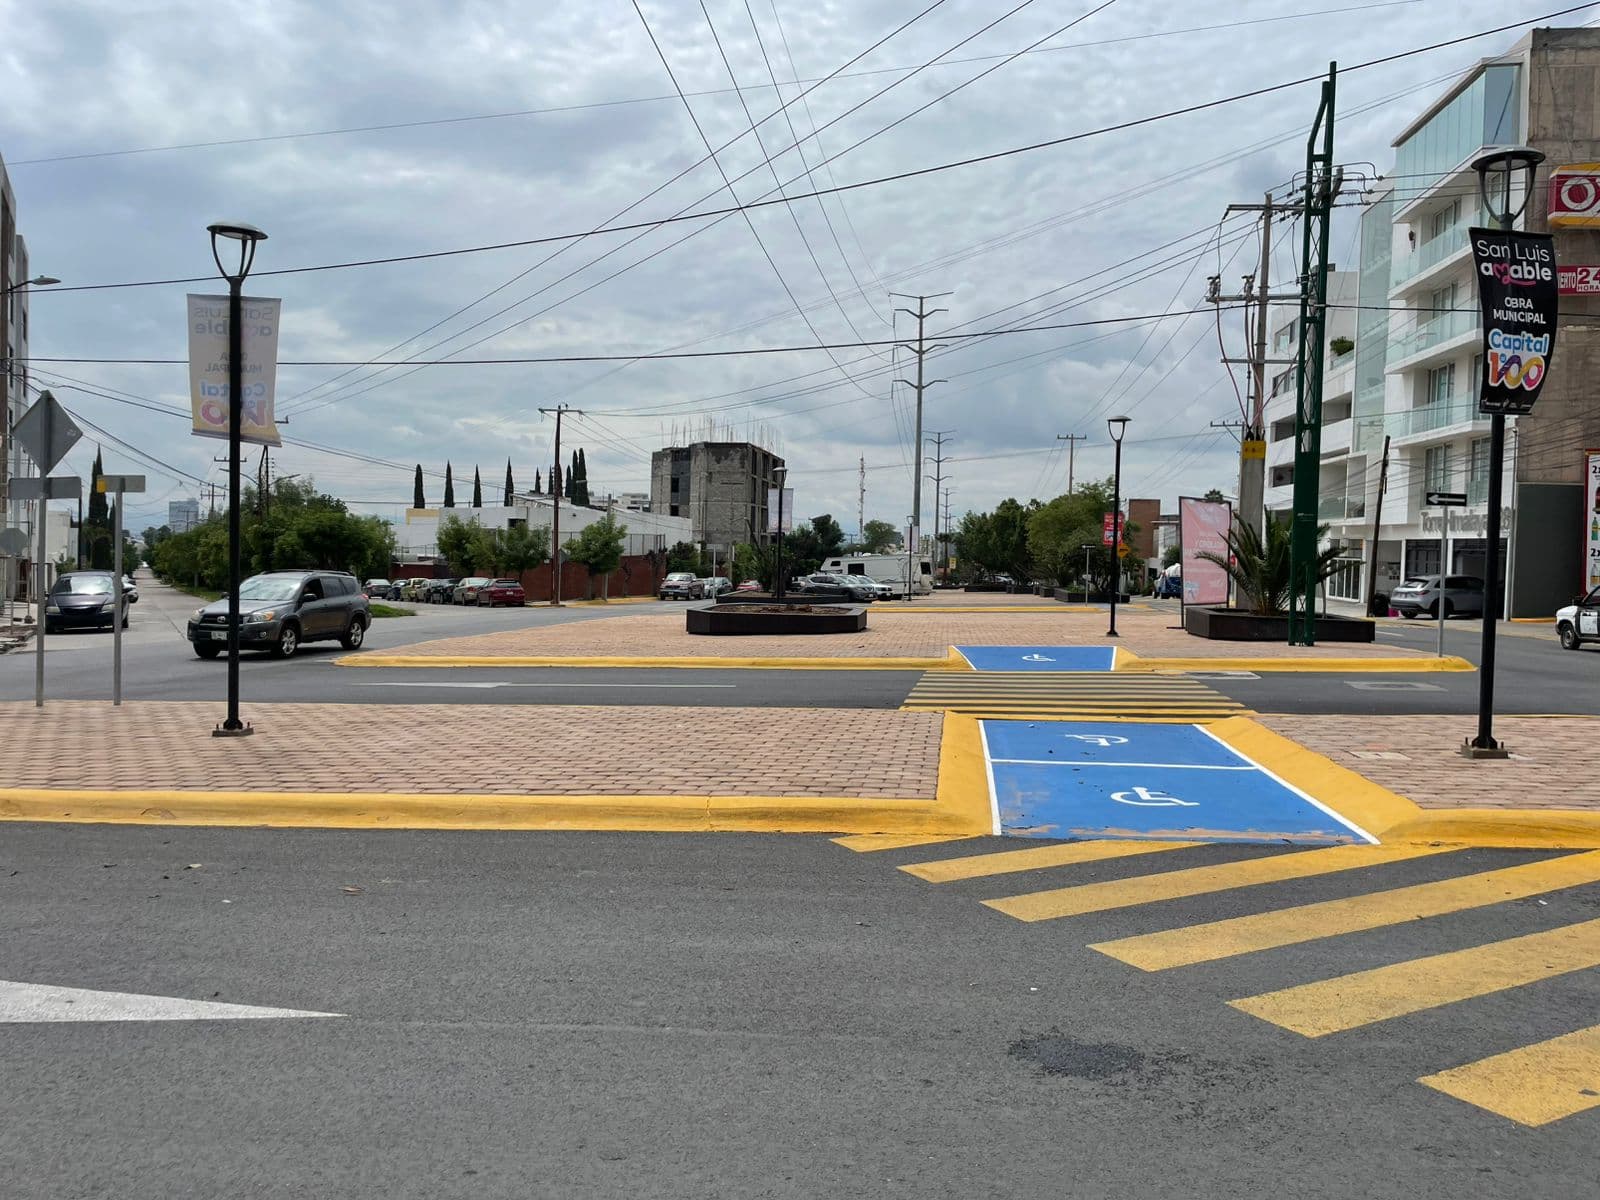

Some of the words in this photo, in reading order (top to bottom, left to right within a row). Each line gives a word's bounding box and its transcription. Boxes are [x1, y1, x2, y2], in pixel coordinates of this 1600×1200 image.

[1476, 240, 1511, 258] San
[1514, 243, 1550, 261] Luis
[1504, 297, 1533, 309] OBRA
[1493, 308, 1547, 324] MUNICIPAL
[1491, 331, 1548, 353] Capital
